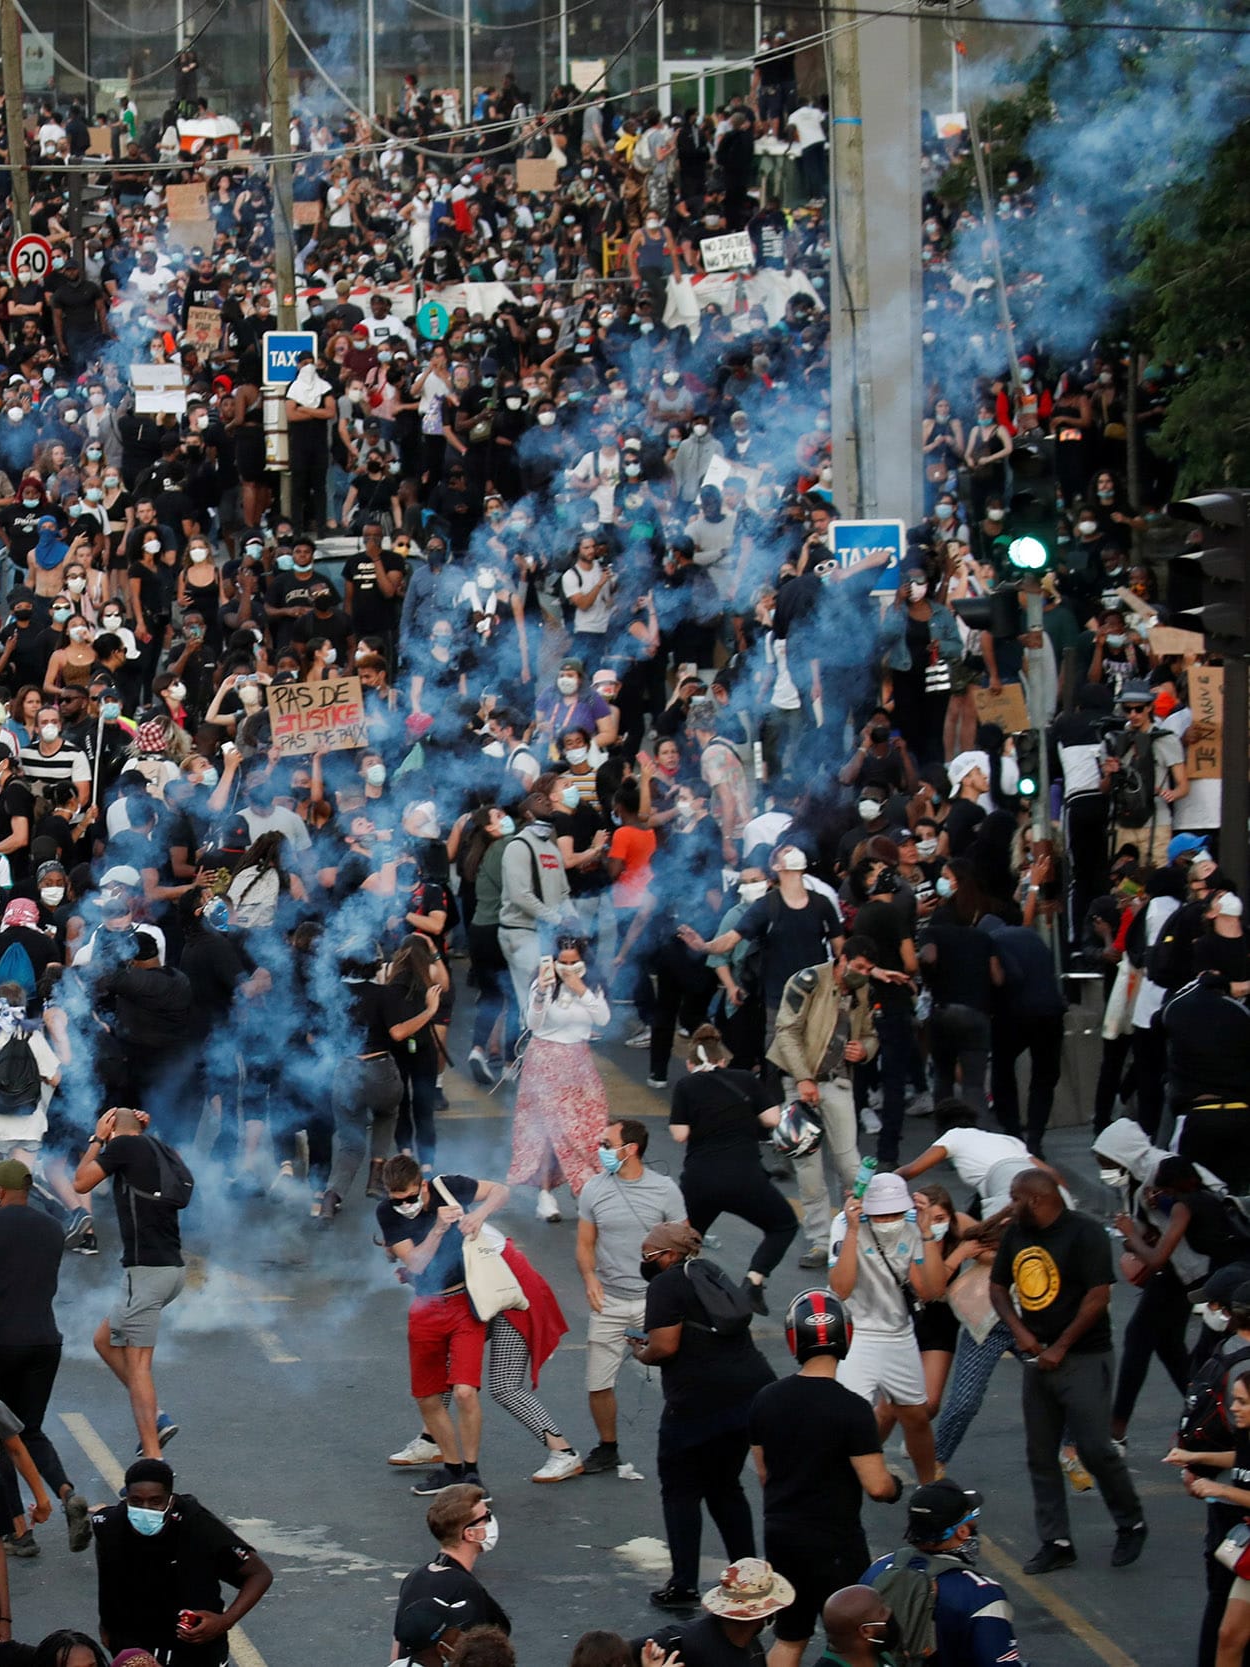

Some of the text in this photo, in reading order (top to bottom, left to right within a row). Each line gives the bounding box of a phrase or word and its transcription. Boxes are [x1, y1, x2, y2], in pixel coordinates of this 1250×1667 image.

[270, 351, 300, 367] TAX
[272, 682, 349, 715] PAS DE
[275, 703, 359, 736] JUSTICE
[279, 722, 367, 749] PAS DE PAIX
